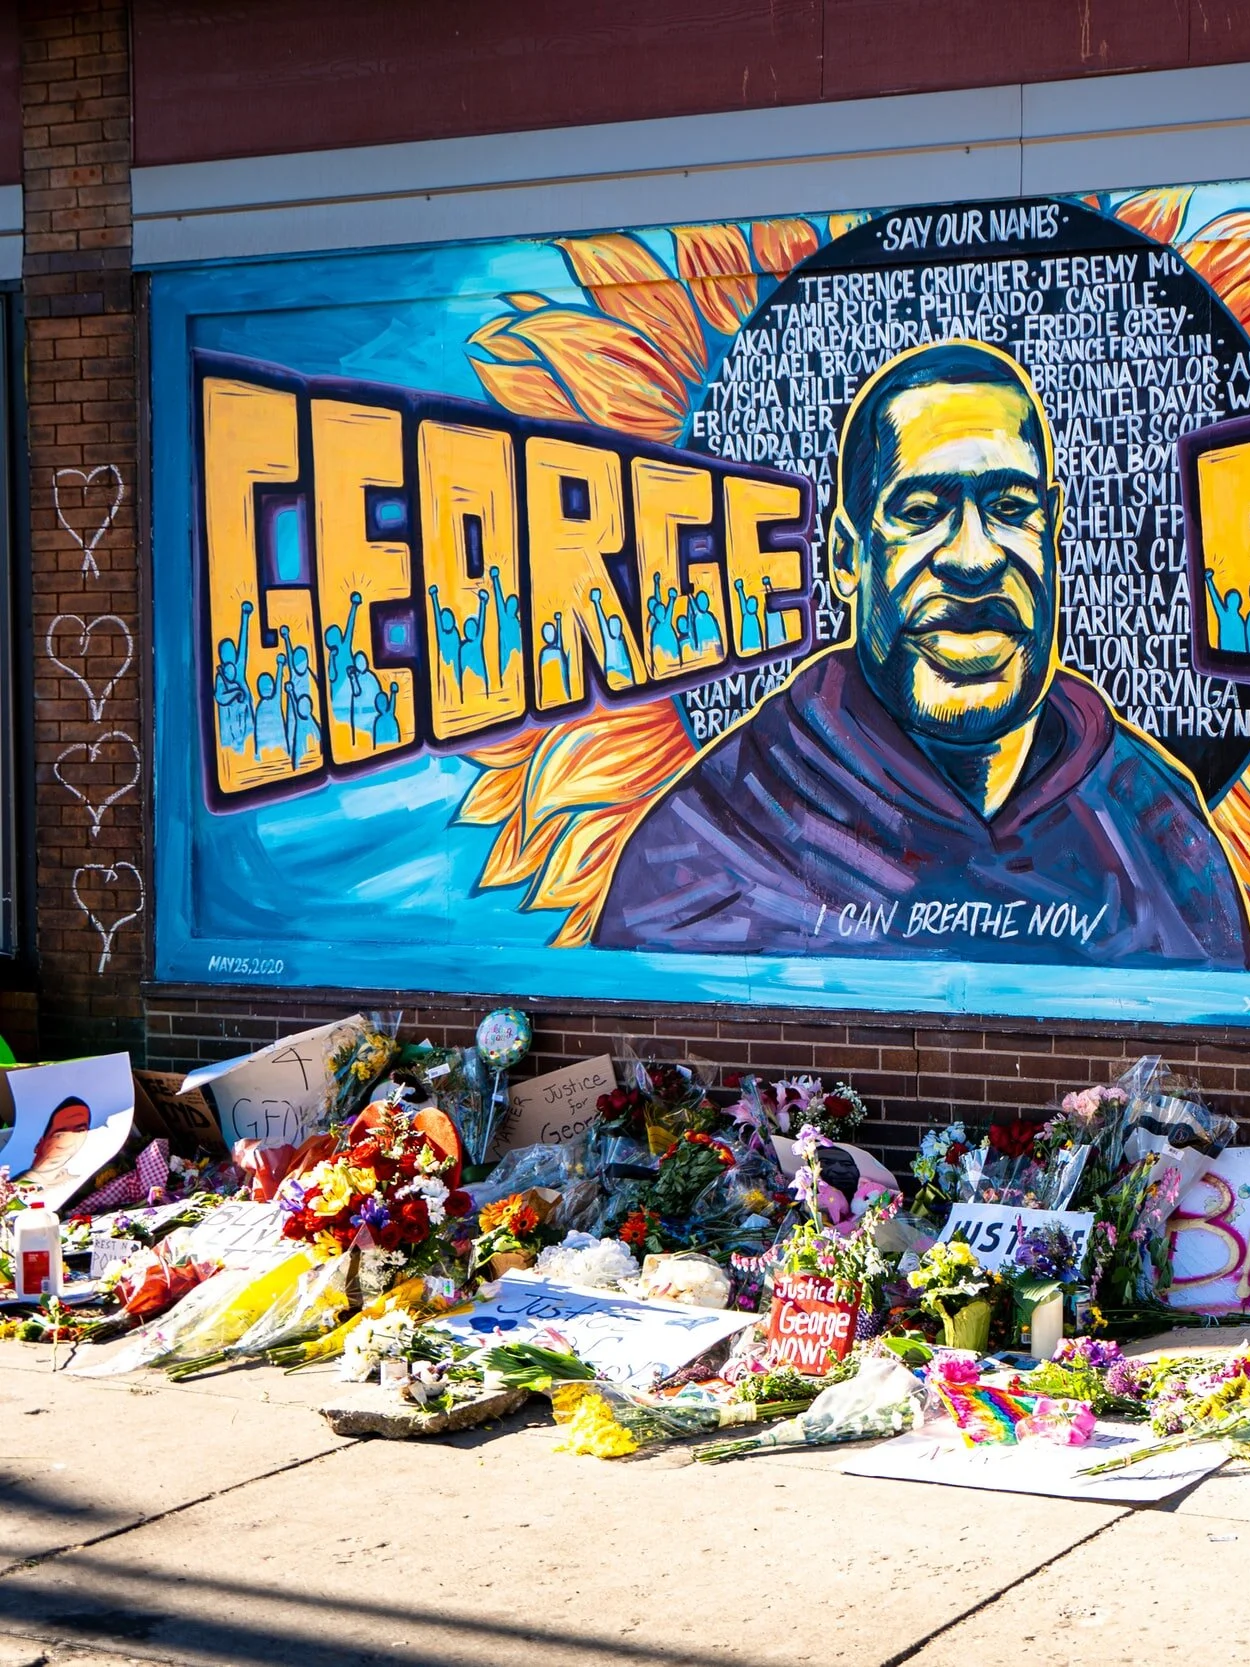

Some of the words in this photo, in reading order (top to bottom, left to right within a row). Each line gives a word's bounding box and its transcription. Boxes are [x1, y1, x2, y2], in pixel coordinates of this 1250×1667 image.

[882, 215, 932, 251] SAY
[936, 210, 988, 248] OUR
[989, 204, 1060, 242] NAMES
[798, 269, 916, 303] TERRENCE
[920, 259, 1029, 297] CRUTCHER
[1038, 254, 1138, 290] JEREMY
[842, 299, 900, 326] RICE
[919, 291, 1043, 319] PHILANDO
[1065, 281, 1158, 313] CASTILE
[732, 328, 778, 357] AKAI
[934, 314, 1007, 342] JAMES
[1024, 312, 1118, 341] FREDDIE
[1124, 305, 1186, 336] GREY
[723, 352, 815, 382] MICHAEL
[1009, 338, 1106, 365] TERRANCE
[1110, 333, 1212, 360] FRANKLIN
[707, 381, 781, 411] TYISHA
[1030, 362, 1134, 394] BREONNA
[1132, 356, 1221, 387] TAYLOR
[693, 410, 743, 438] ERIC
[743, 406, 837, 435] GARNER
[1042, 387, 1146, 421] SHANTEL
[1150, 383, 1217, 413] DAVIS
[708, 434, 794, 463] SANDRA
[1048, 416, 1143, 449] WALTER
[1054, 445, 1123, 477] REKIA
[1131, 472, 1177, 507] SMI
[1061, 506, 1146, 539] SHELLY
[1060, 540, 1144, 575] JAMAR
[203, 376, 804, 795] GEORGE
[1059, 573, 1165, 607] TANISHA
[1060, 606, 1150, 635] TARIKA
[1061, 635, 1139, 671] ALTON
[1144, 634, 1189, 669] STE
[1092, 669, 1240, 709] KORRYNGA
[1126, 705, 1250, 738] KATHRYN
[813, 902, 827, 936] I
[838, 900, 899, 939] CAN
[902, 900, 1026, 939] BREATHE
[1027, 902, 1109, 945] NOW
[543, 1073, 607, 1104] Justice
[569, 1097, 588, 1115] for
[779, 1301, 851, 1347] George
